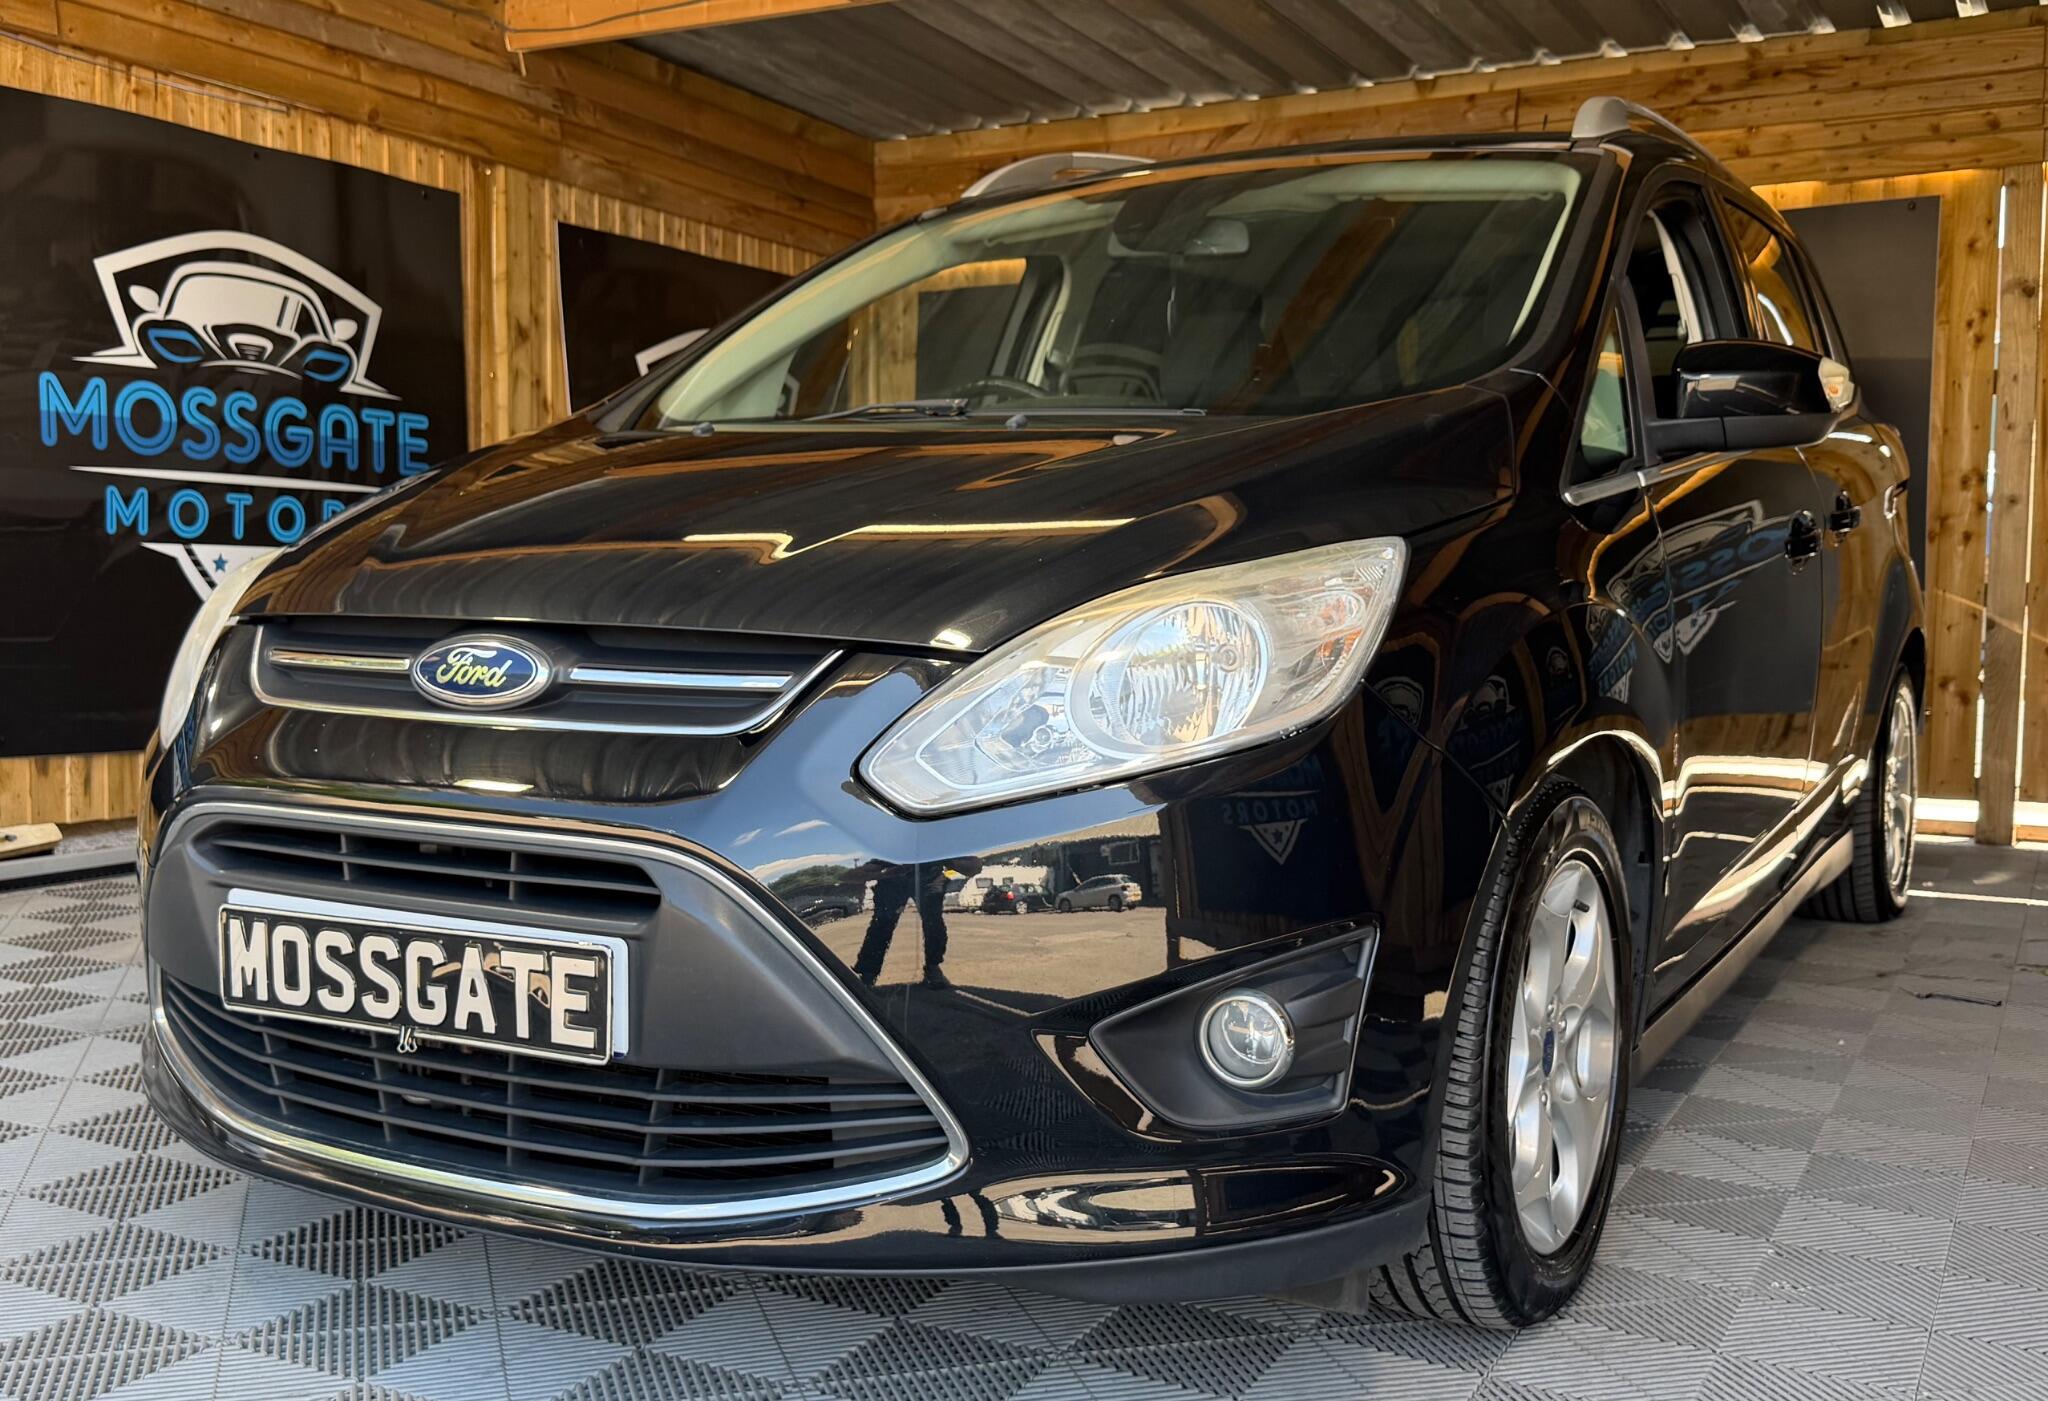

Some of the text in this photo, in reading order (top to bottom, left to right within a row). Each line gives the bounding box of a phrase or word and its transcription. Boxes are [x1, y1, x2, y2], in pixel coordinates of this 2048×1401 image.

[39, 371, 430, 477] MOSSGATE
[436, 647, 513, 688] Ford
[228, 916, 599, 1049] MOSSGATE
